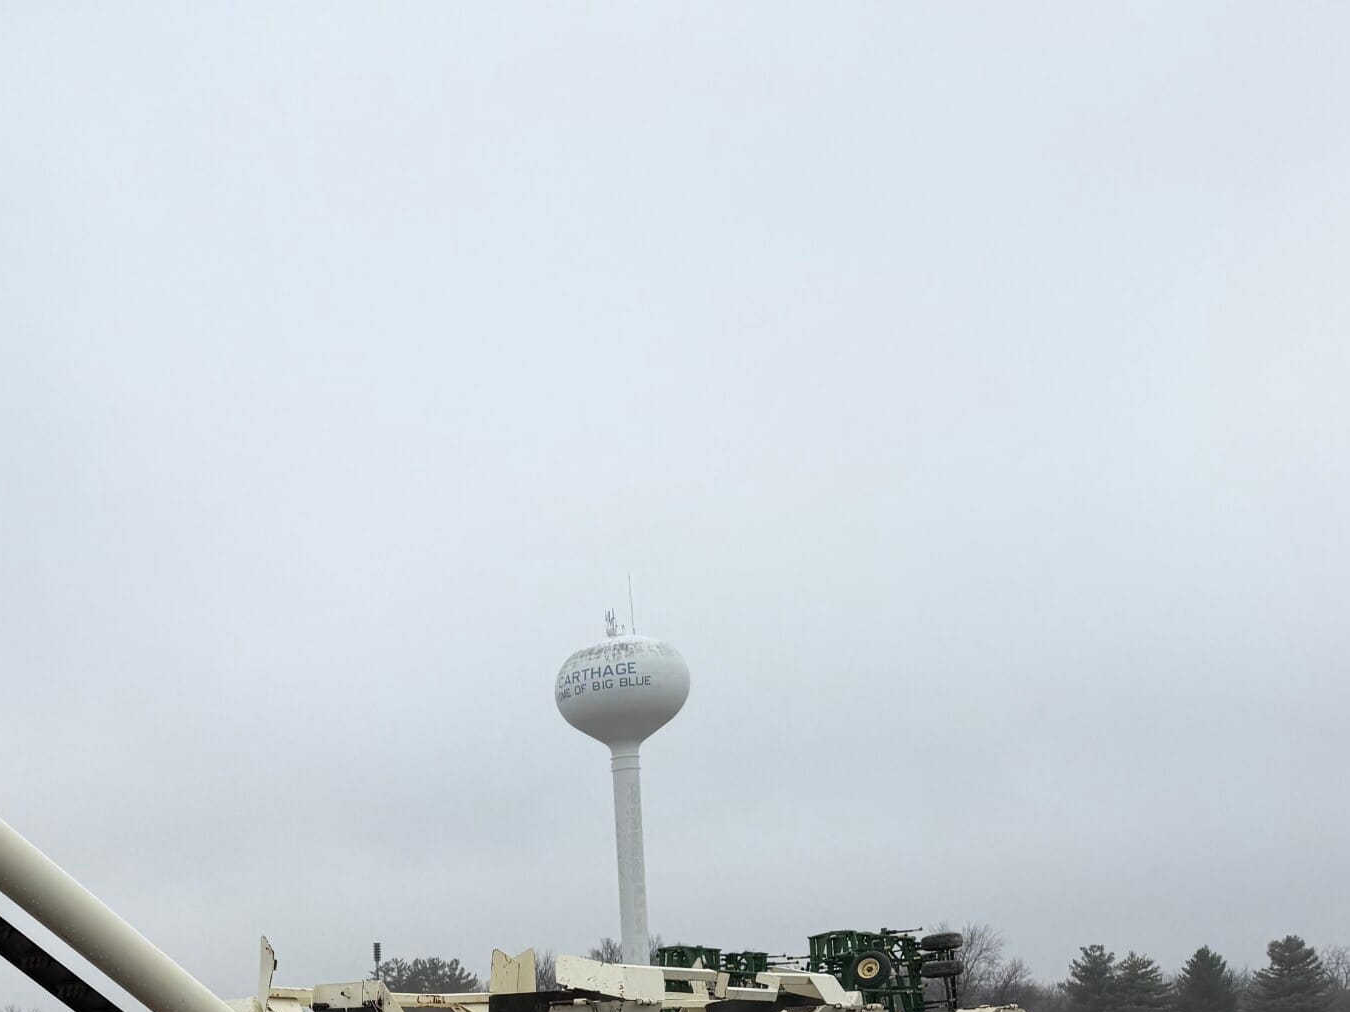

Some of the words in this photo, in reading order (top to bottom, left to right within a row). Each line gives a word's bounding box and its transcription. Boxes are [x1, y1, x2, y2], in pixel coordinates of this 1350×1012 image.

[558, 662, 637, 688] CARTHAGE
[574, 684, 587, 696] OF
[592, 679, 614, 691] BIG
[619, 675, 652, 688] BLUE
